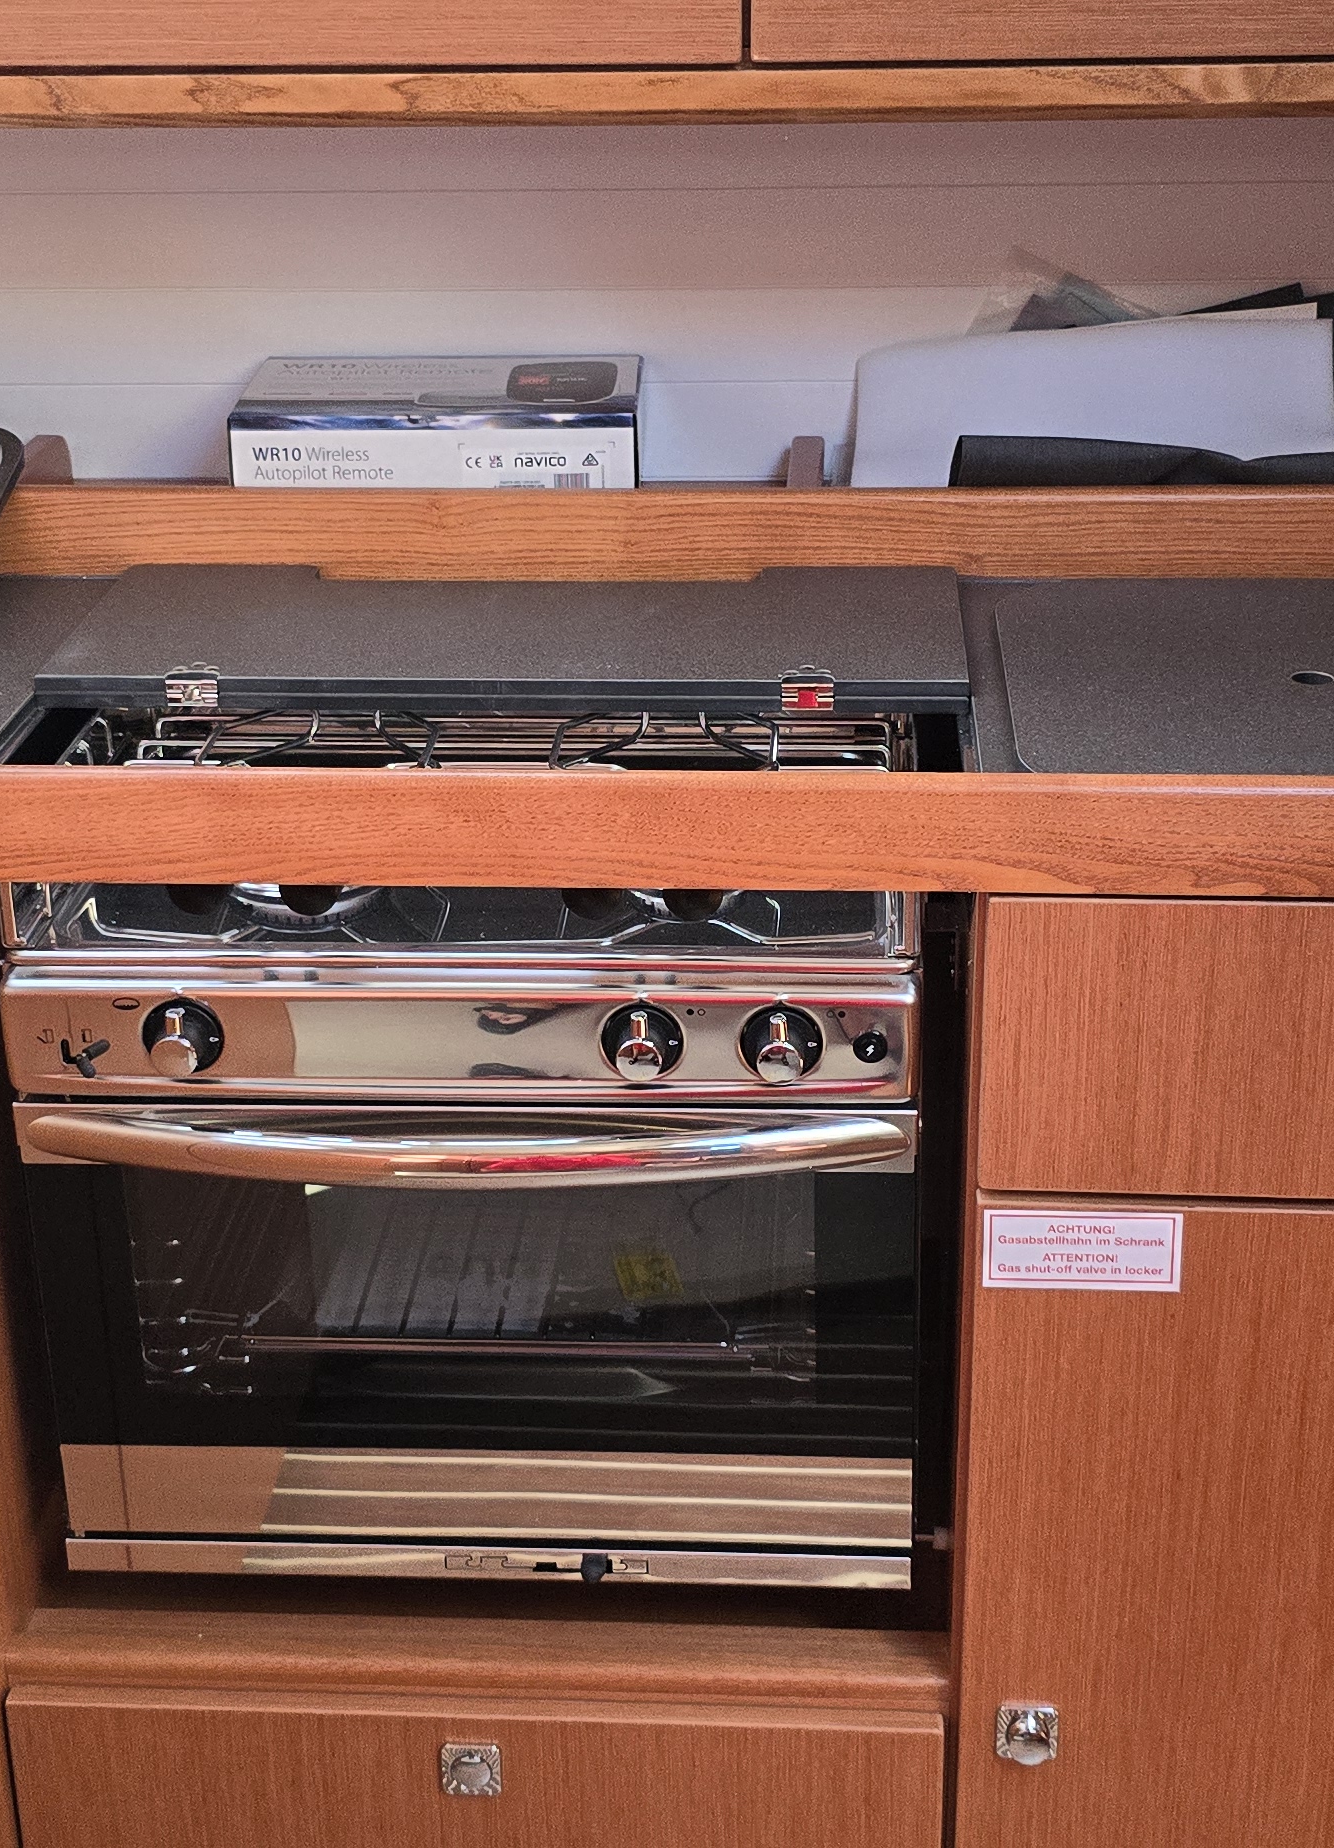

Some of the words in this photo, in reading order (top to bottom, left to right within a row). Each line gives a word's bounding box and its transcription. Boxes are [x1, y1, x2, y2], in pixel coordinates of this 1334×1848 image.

[252, 447, 302, 461] WR10
[305, 446, 369, 461] Wireless
[515, 456, 566, 468] navico
[254, 465, 327, 483] Autopilot
[333, 465, 393, 480] Remote
[1047, 1224, 1115, 1235] ACHTUNG!
[997, 1235, 1092, 1246] Gasabstellhahn
[1096, 1237, 1110, 1246] im
[1114, 1237, 1165, 1247] Schrank
[1042, 1253, 1118, 1263] ATTENTION!
[997, 1264, 1021, 1273] Gas
[1025, 1264, 1072, 1274] shut-off
[1076, 1265, 1107, 1275] valve
[1111, 1266, 1122, 1275] in
[1125, 1266, 1164, 1276] locker
